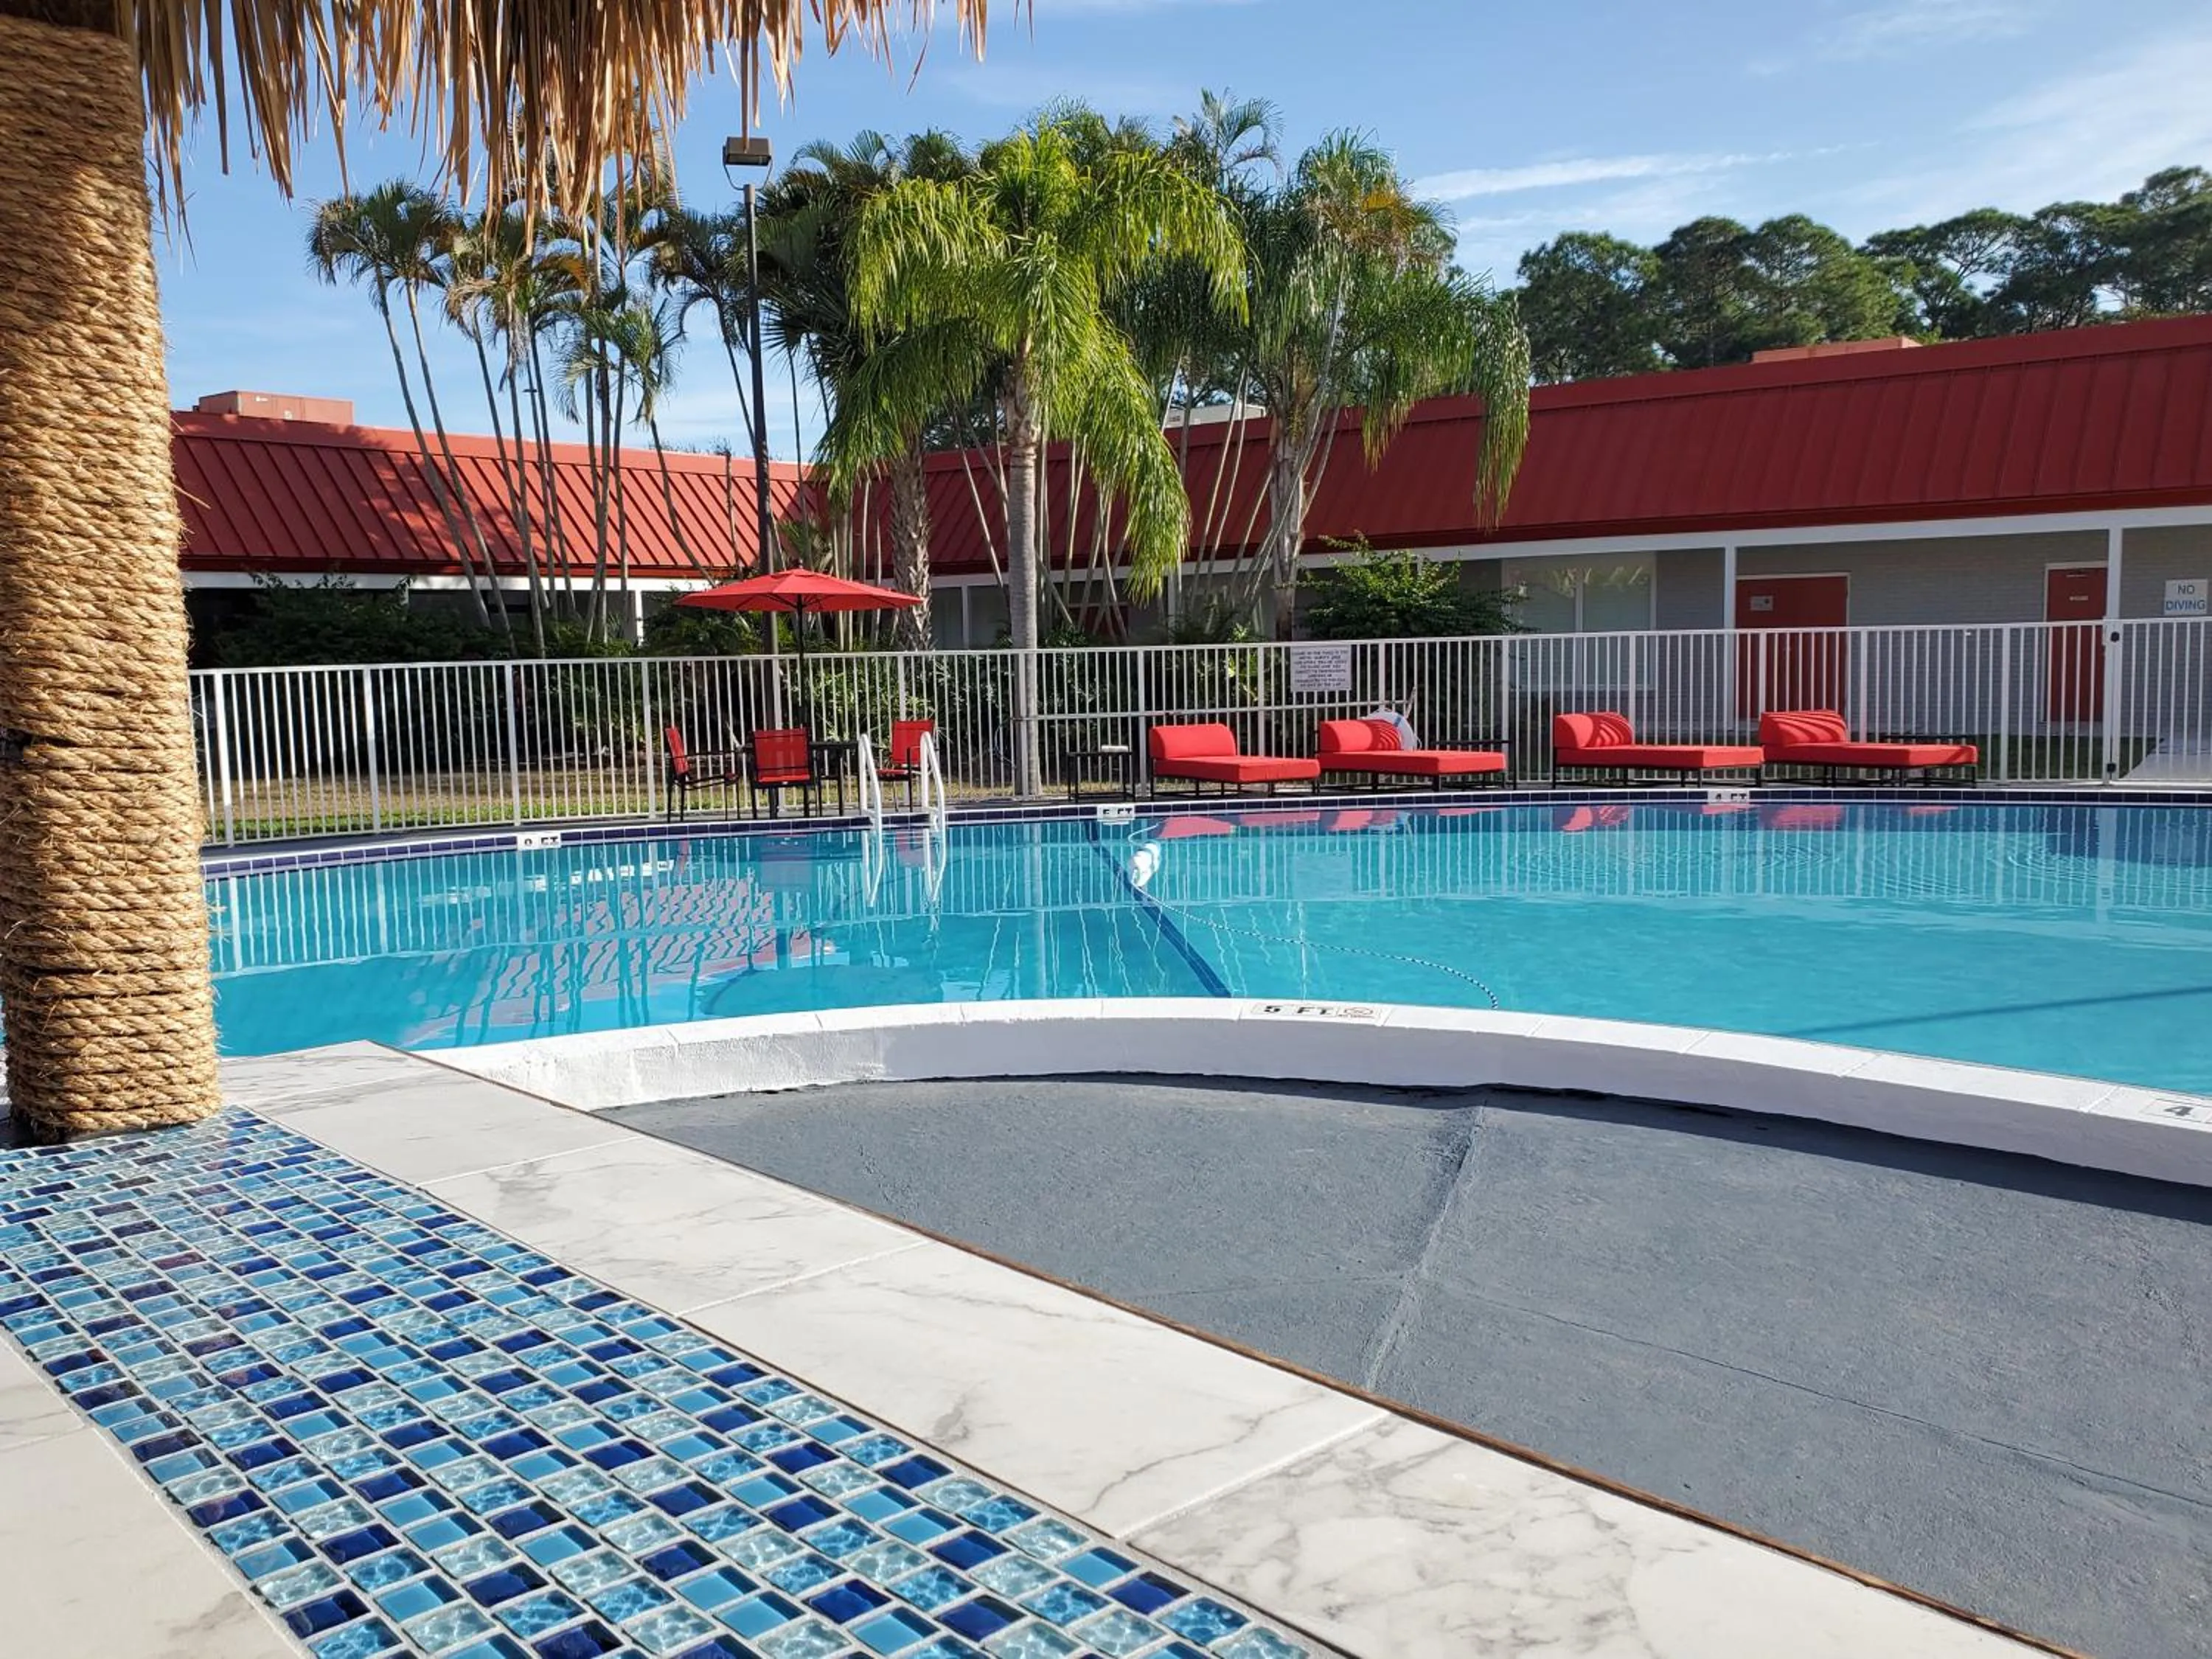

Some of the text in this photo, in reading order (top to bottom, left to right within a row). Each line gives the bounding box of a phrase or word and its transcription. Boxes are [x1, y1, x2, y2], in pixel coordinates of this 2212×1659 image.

[2177, 584, 2195, 594] NO
[2166, 599, 2205, 611] DIVING
[1264, 1005, 1334, 1015] 5 FT
[2164, 1105, 2194, 1116] 4
